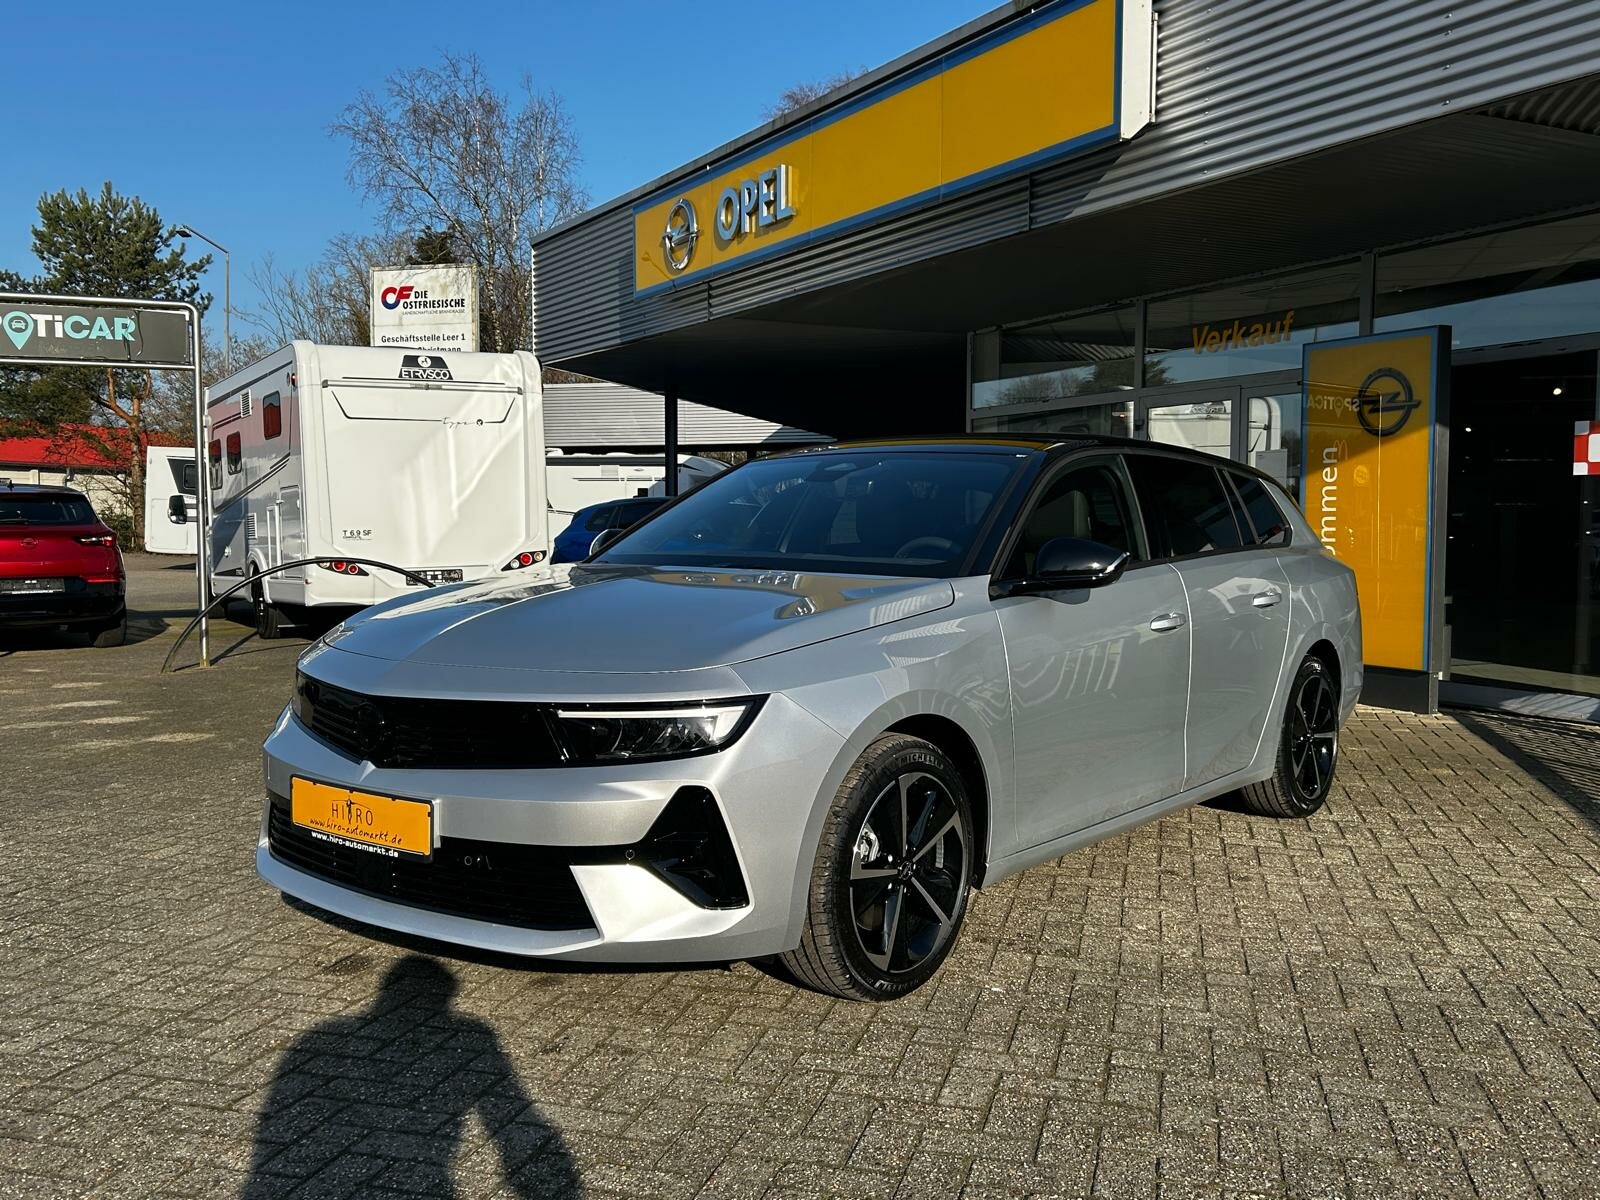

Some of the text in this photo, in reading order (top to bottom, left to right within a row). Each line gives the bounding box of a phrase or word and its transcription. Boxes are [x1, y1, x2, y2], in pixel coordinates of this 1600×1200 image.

[716, 163, 795, 241] OPEL
[402, 298, 466, 310] OSTFRIESISCHE
[414, 290, 428, 299] DIE
[381, 333, 466, 343] Geschäftsstelle Leer 1
[1192, 310, 1295, 355] Verkauf
[332, 802, 373, 826] HIRO
[309, 818, 402, 845] www.hiro-automarkt.de
[311, 831, 399, 858] www.hiro-automarkt.de
